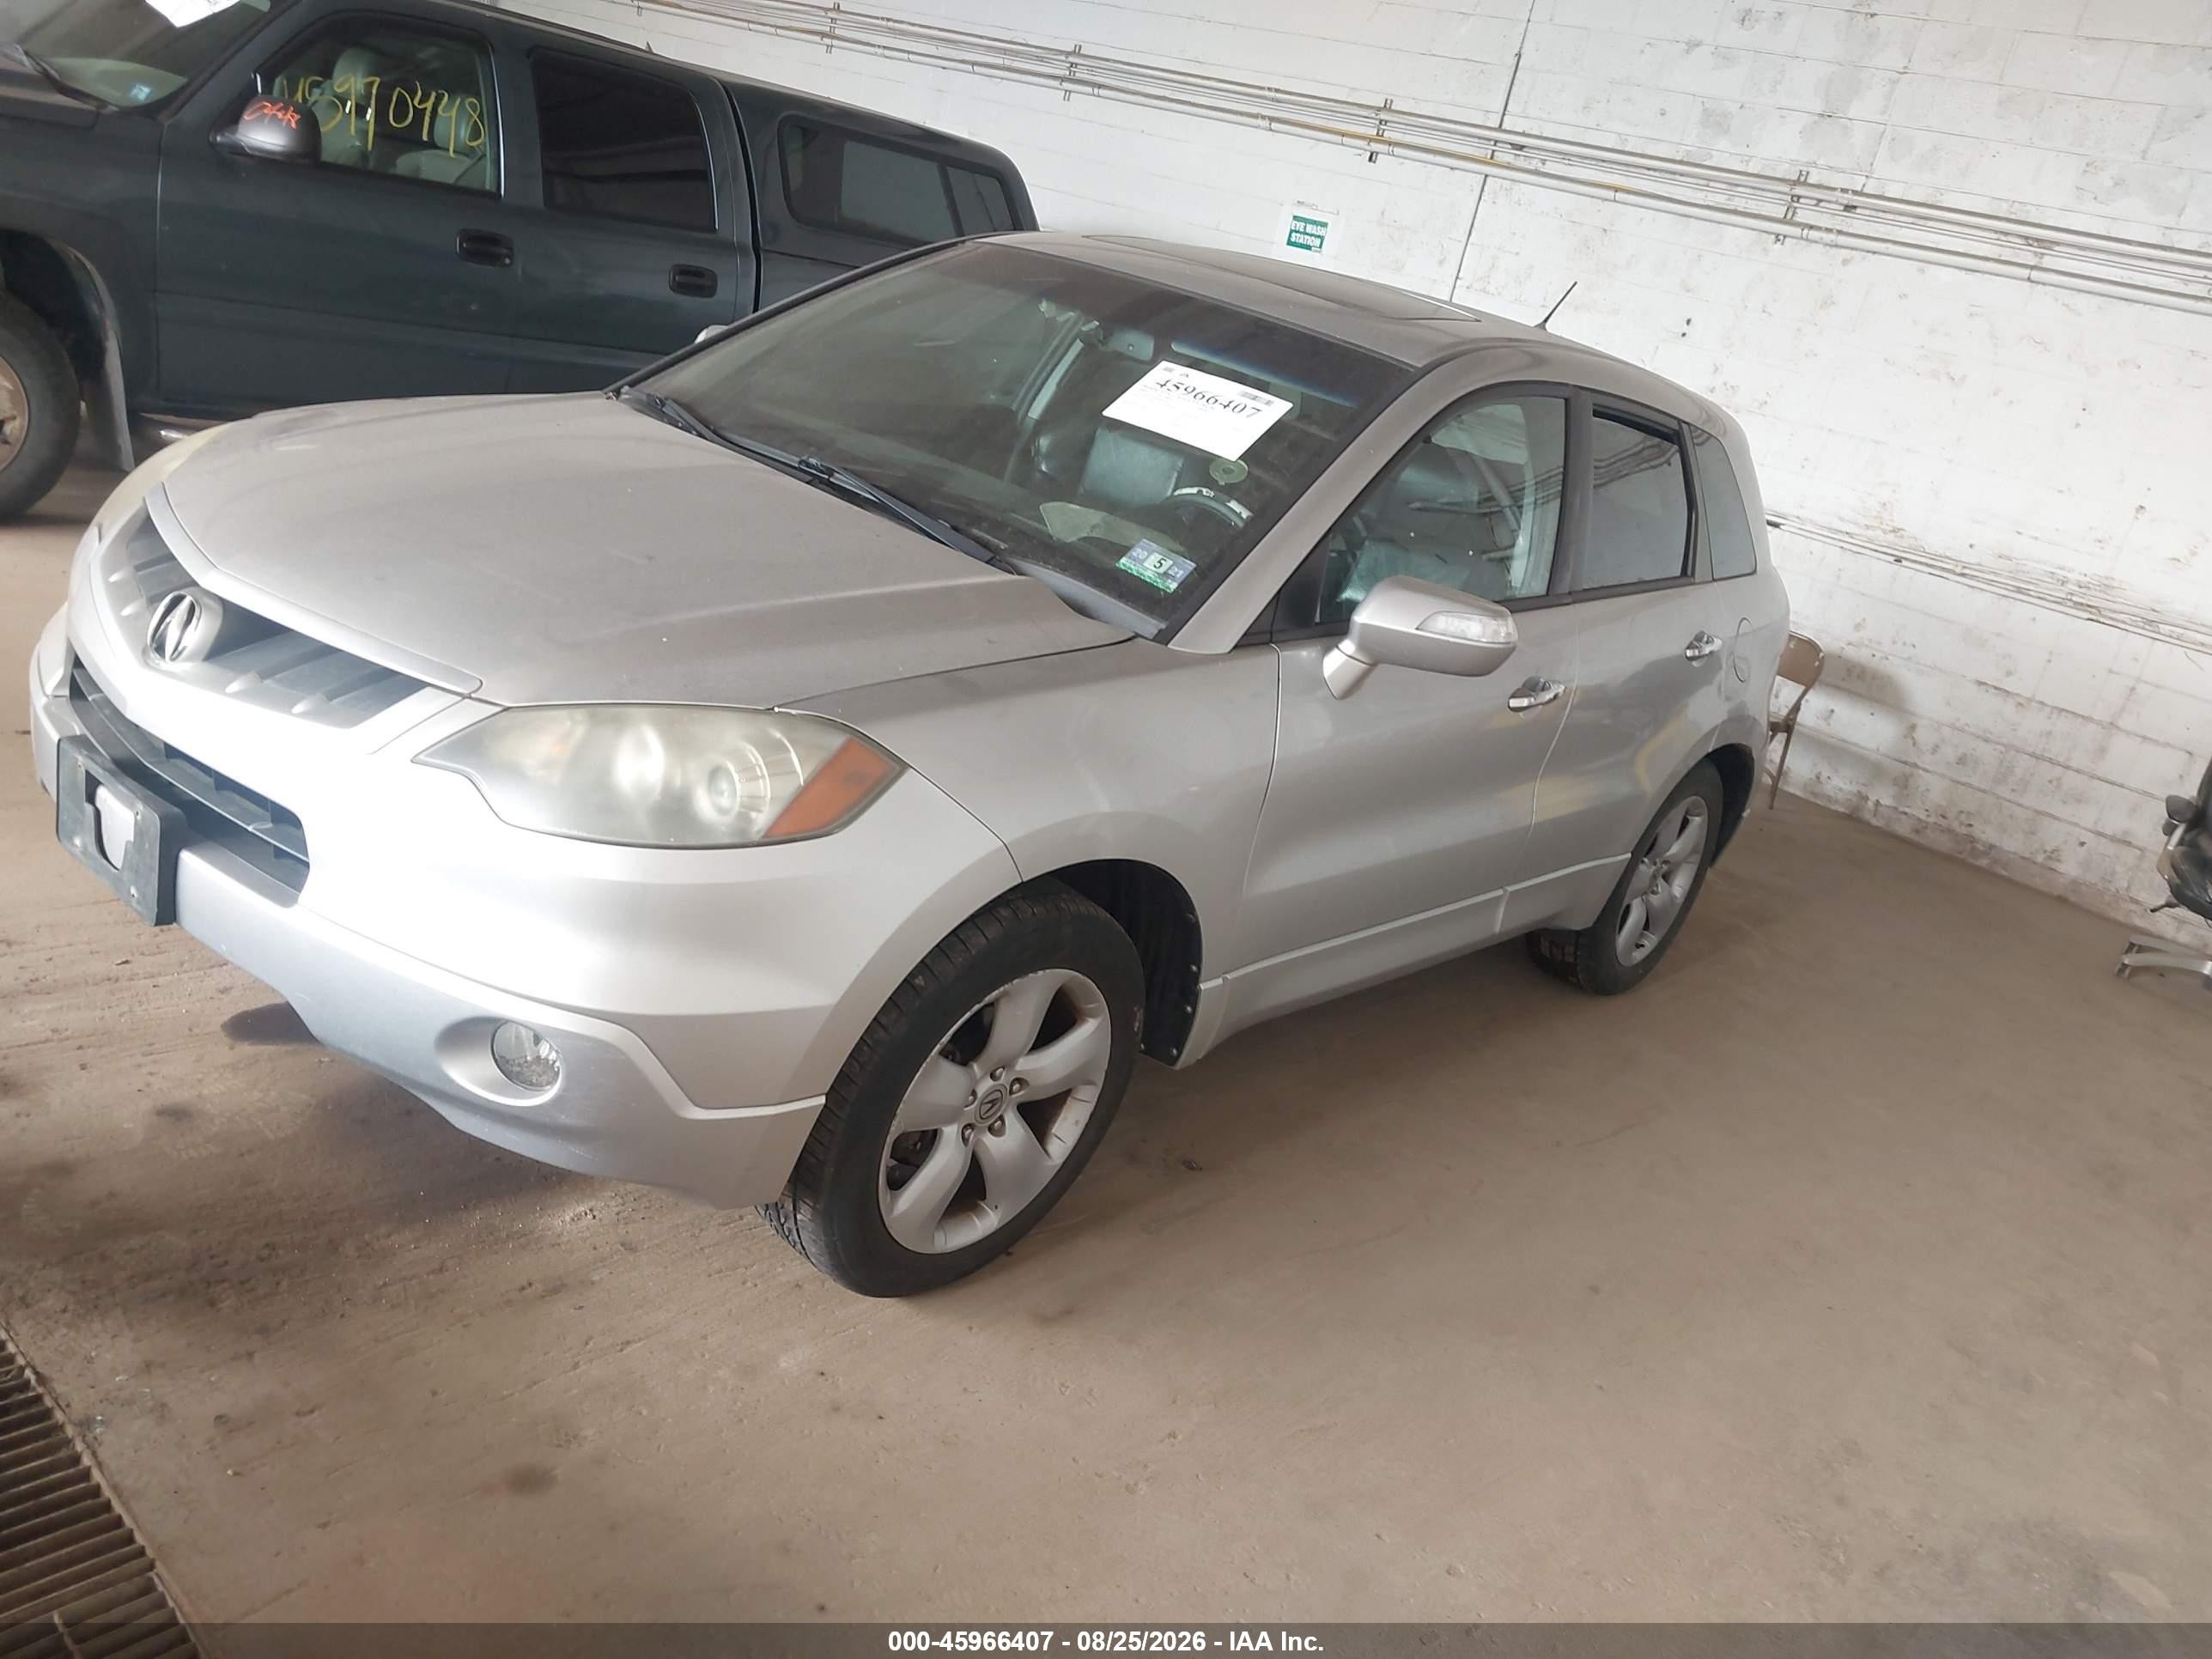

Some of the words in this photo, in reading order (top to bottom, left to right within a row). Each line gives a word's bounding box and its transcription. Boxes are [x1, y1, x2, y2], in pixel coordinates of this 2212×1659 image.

[1291, 221, 1305, 232] EYE
[1305, 223, 1328, 236] WASH
[1291, 233, 1322, 248] STATION
[1155, 378, 1263, 419] 45966407
[1153, 557, 1168, 569] 5
